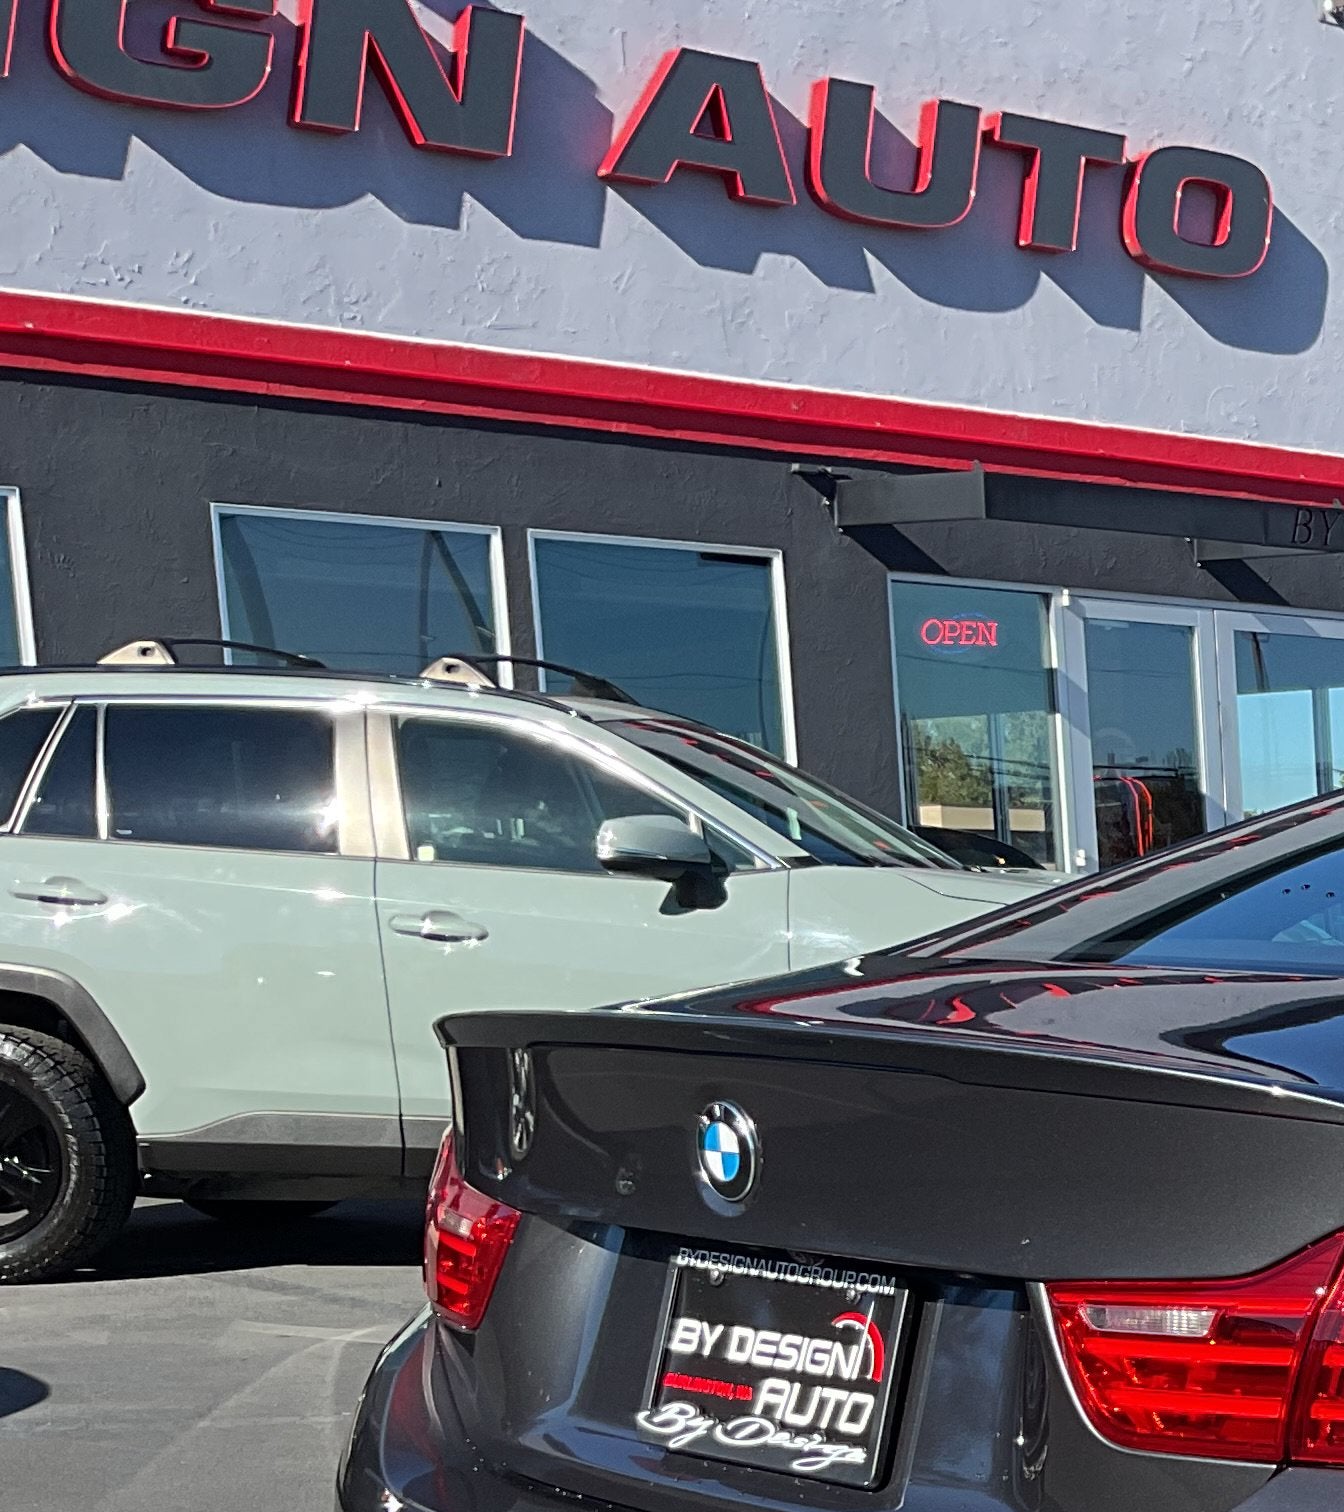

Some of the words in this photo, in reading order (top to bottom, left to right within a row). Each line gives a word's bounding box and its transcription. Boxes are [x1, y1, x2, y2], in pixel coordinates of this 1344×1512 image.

[0, 0, 524, 157] GN
[600, 46, 1274, 279] AUTO
[1291, 506, 1343, 547] BY
[920, 617, 999, 648] OPEN
[667, 1316, 725, 1357] BY
[726, 1325, 862, 1381] DESIGN
[635, 1401, 715, 1449] By
[752, 1376, 877, 1435] AUTO
